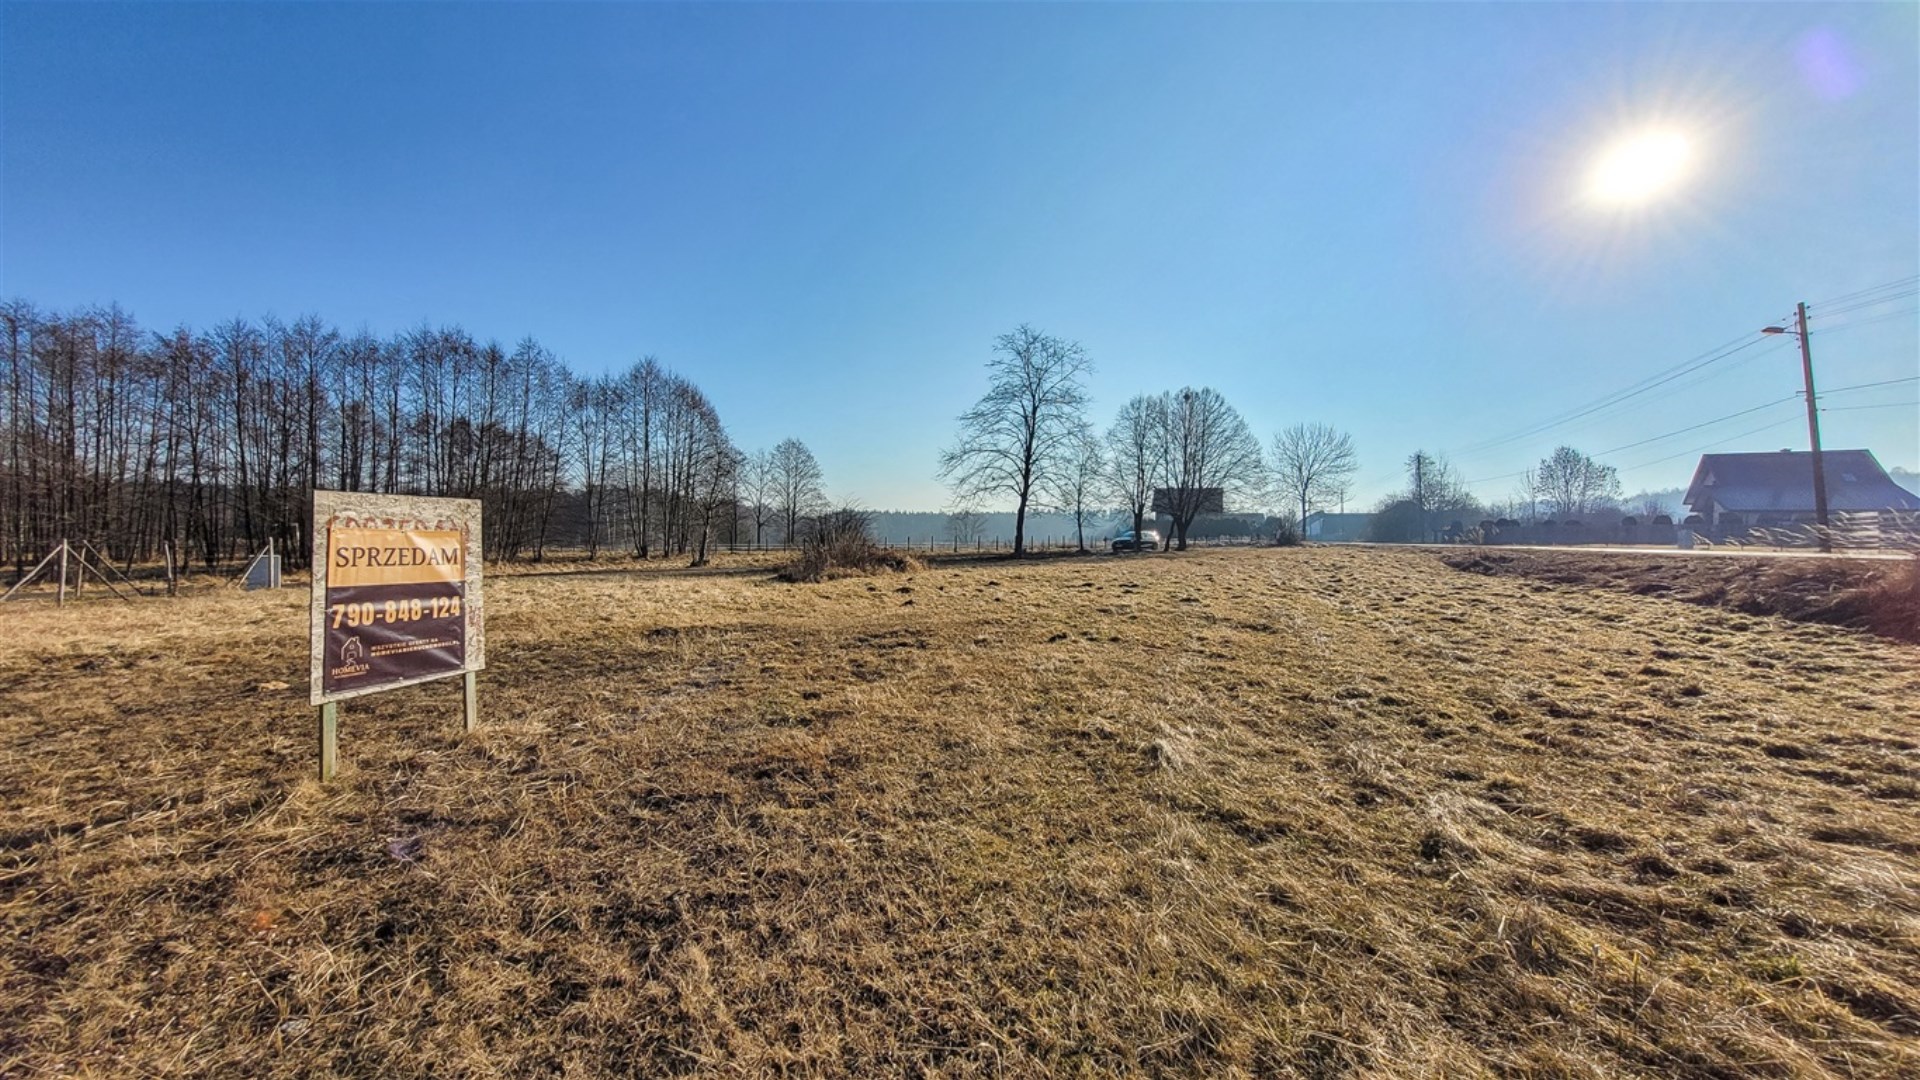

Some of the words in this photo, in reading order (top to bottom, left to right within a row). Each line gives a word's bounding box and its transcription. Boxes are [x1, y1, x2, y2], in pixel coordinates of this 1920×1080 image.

[335, 546, 460, 567] SPRZEDAM
[332, 595, 461, 629] 790-848-124
[331, 663, 370, 676] HOMEVIA
